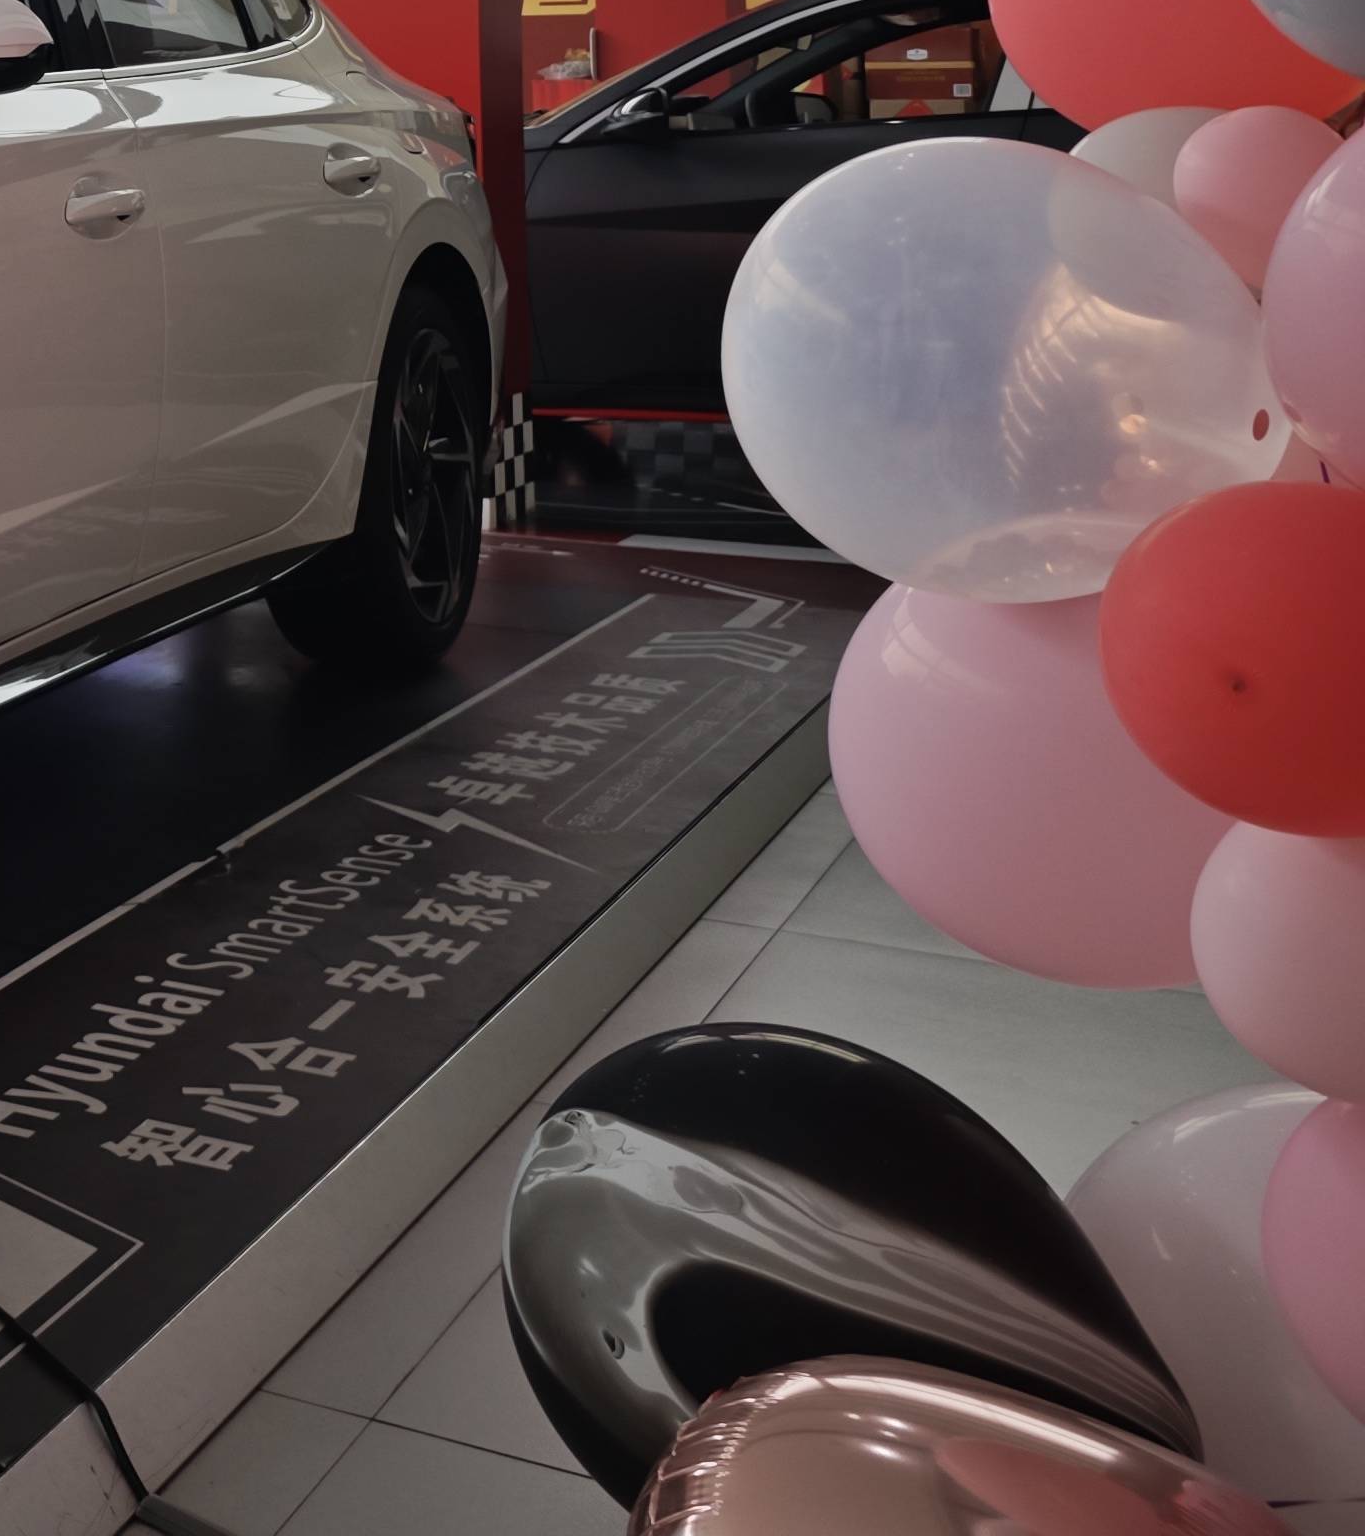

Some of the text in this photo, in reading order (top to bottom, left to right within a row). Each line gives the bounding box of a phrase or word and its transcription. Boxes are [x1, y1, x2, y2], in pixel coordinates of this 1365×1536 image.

[427, 672, 687, 806] 卓越技术品质
[165, 831, 433, 982] SmartSense
[101, 870, 553, 1171] 智心合一安全系统
